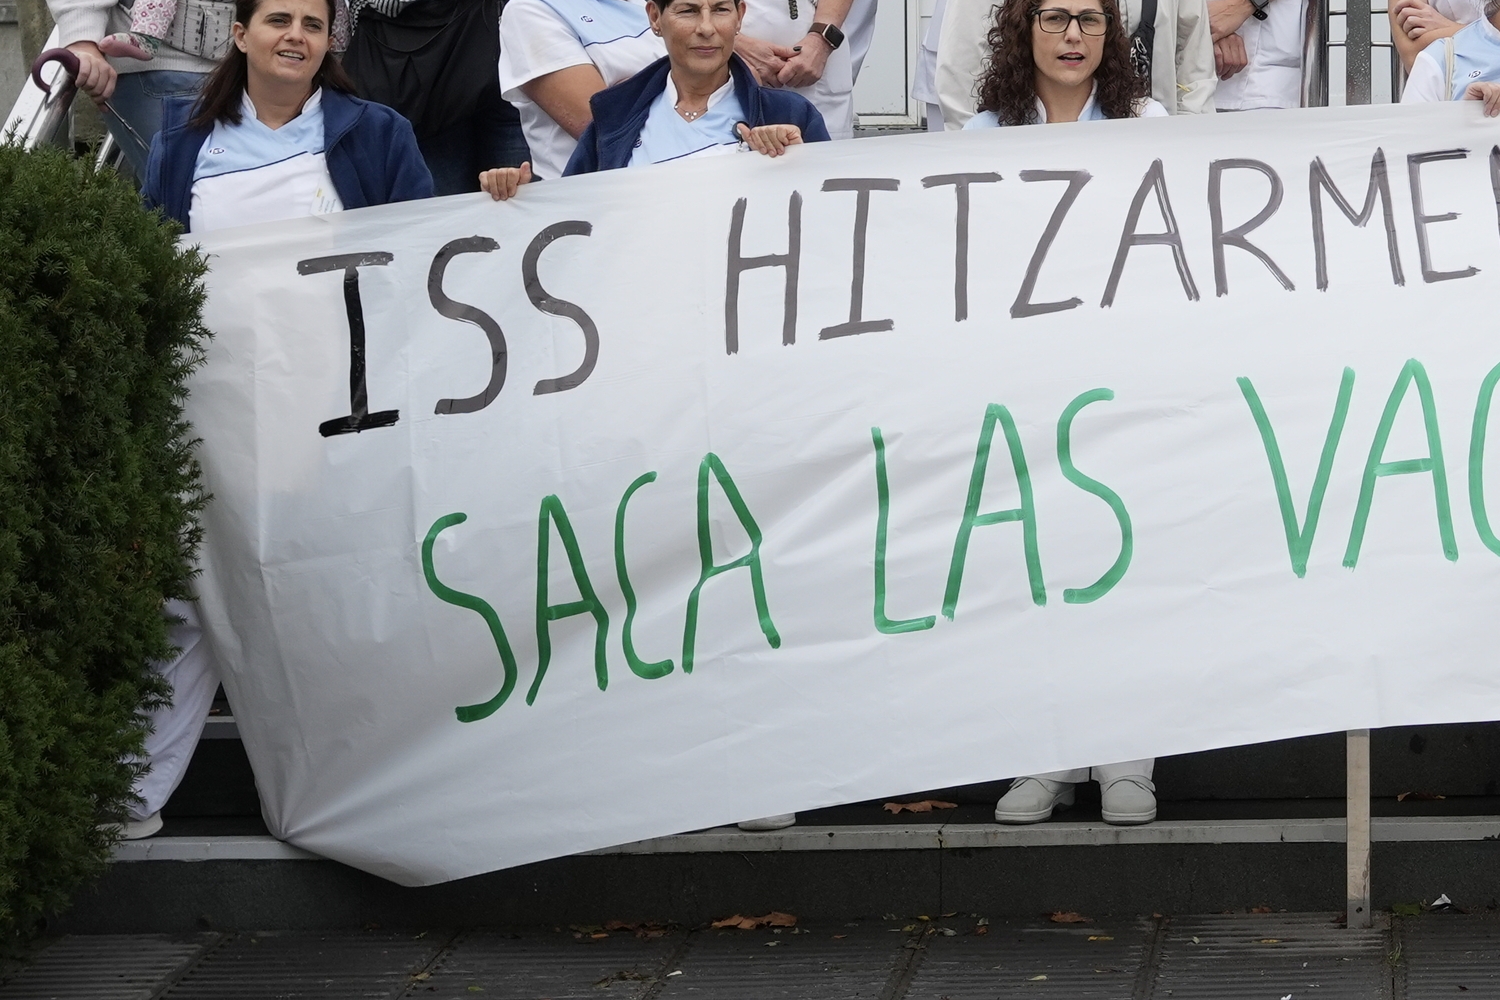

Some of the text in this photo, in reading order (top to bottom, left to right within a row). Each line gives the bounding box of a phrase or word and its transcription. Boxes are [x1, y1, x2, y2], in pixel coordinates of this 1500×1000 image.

[296, 220, 601, 438] ISS
[421, 452, 783, 724] SACA
[870, 386, 1135, 636] LAS
